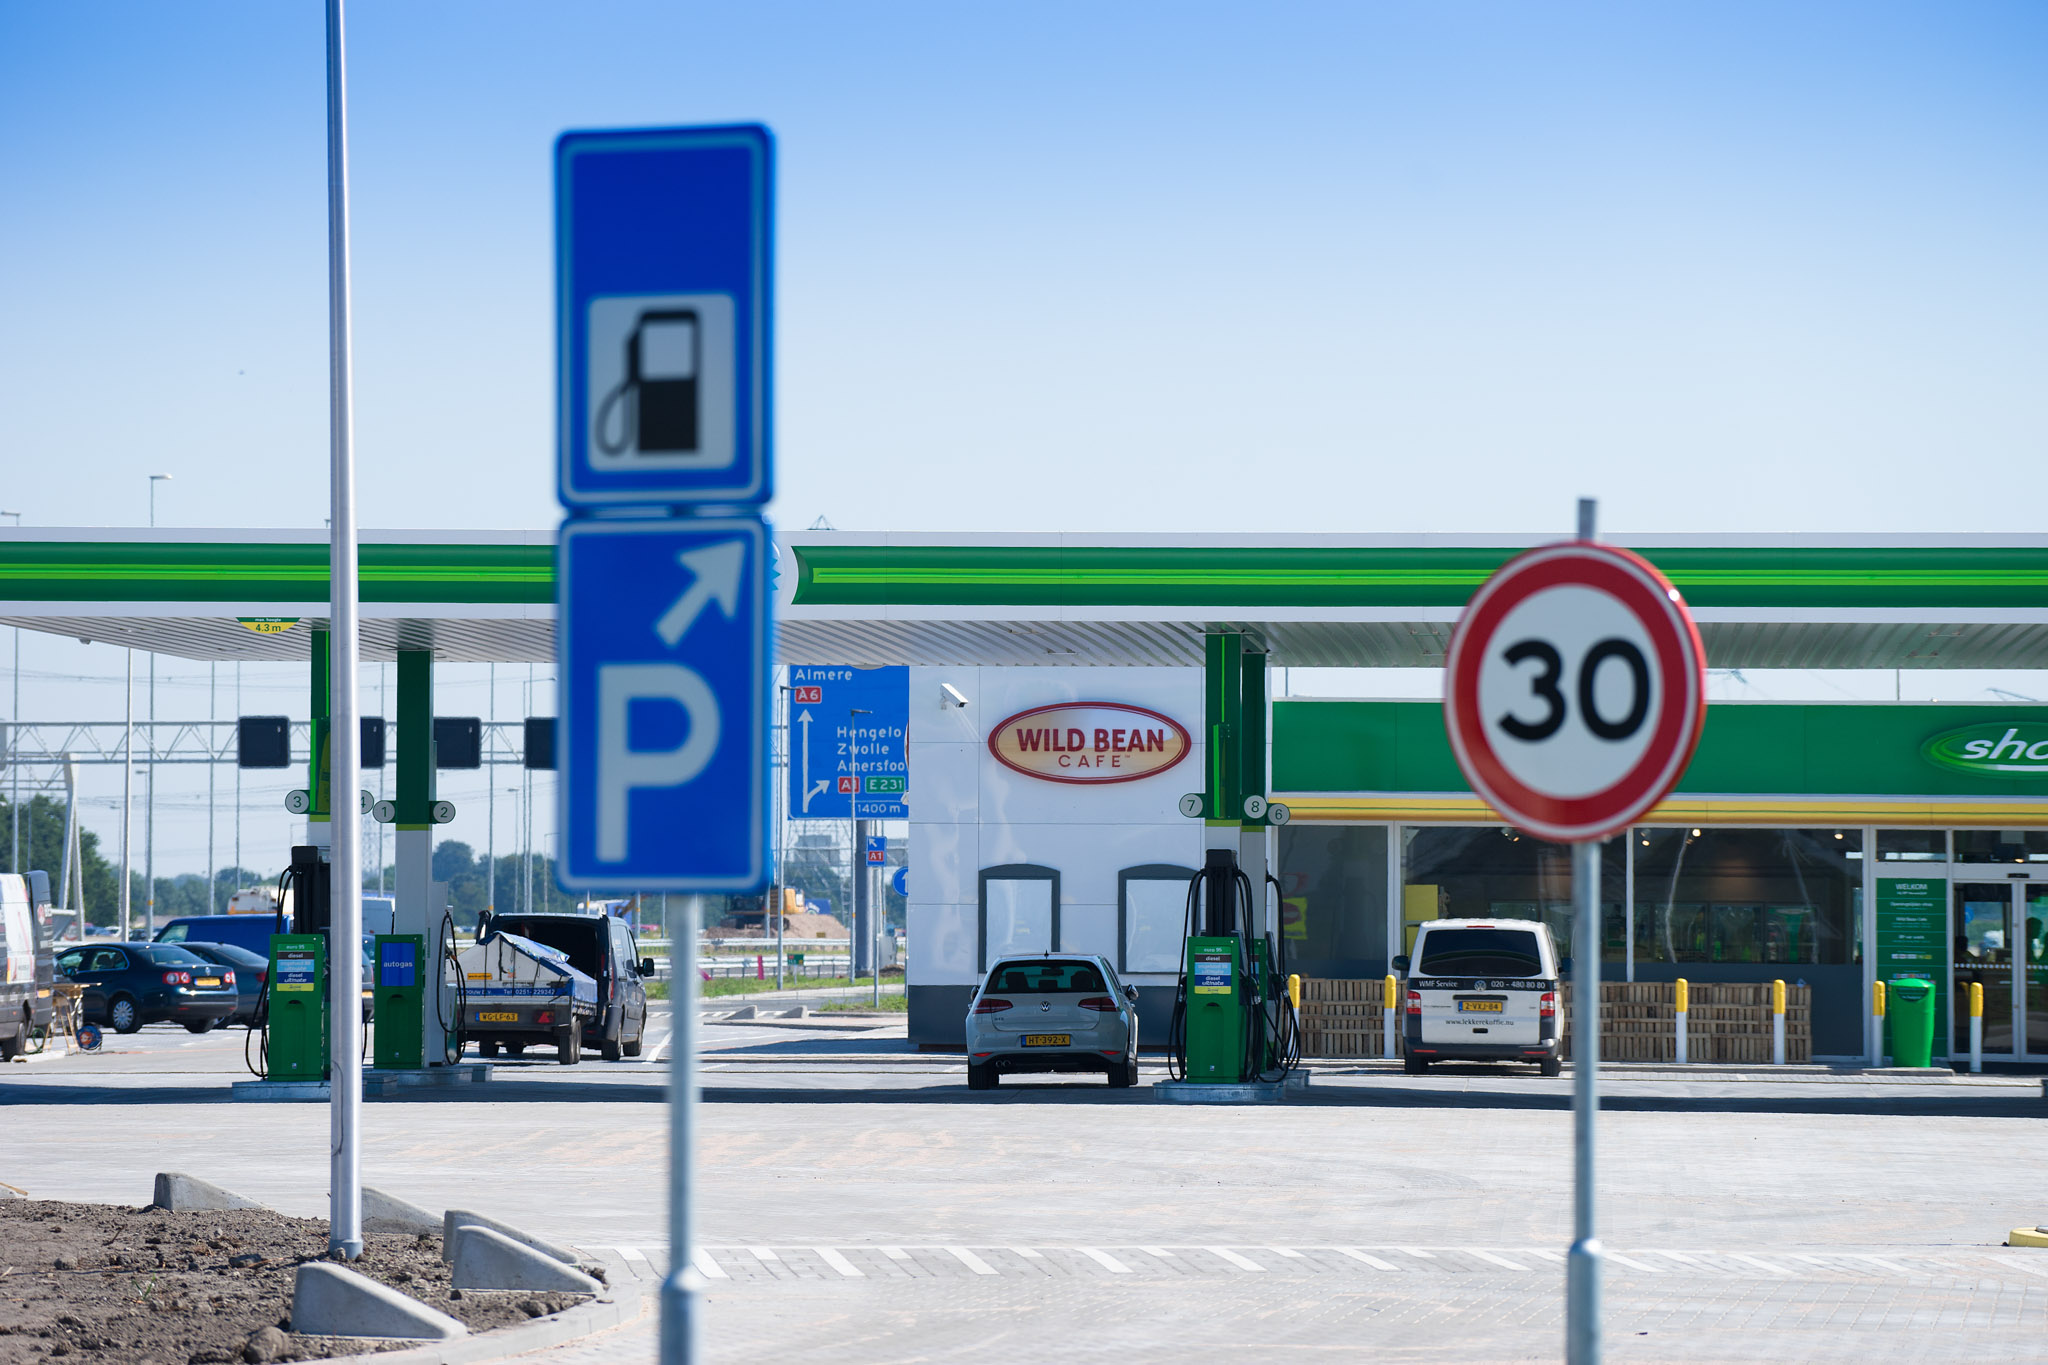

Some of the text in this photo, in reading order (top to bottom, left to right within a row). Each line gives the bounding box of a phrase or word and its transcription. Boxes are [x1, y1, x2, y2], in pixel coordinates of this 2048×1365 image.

[256, 624, 270, 632] 4.3
[795, 669, 852, 680] Almere
[798, 688, 819, 700] A6
[1498, 638, 1650, 743] 30
[837, 726, 902, 740] Hengelo
[1016, 728, 1164, 752] WILD BEAN
[837, 743, 890, 755] Zwolle
[596, 663, 720, 862] P
[1058, 754, 1121, 768] CAFE
[841, 780, 857, 790] A1
[293, 796, 302, 808] 3
[1187, 800, 1196, 812] 7
[1251, 800, 1260, 813] 8
[382, 806, 388, 818] 1
[440, 806, 448, 818] 2
[858, 804, 900, 814] 1400 m
[1274, 808, 1283, 820] 6
[870, 852, 882, 860] A1
[383, 960, 413, 969] autogas
[1028, 1035, 1066, 1044] HT-392-X
